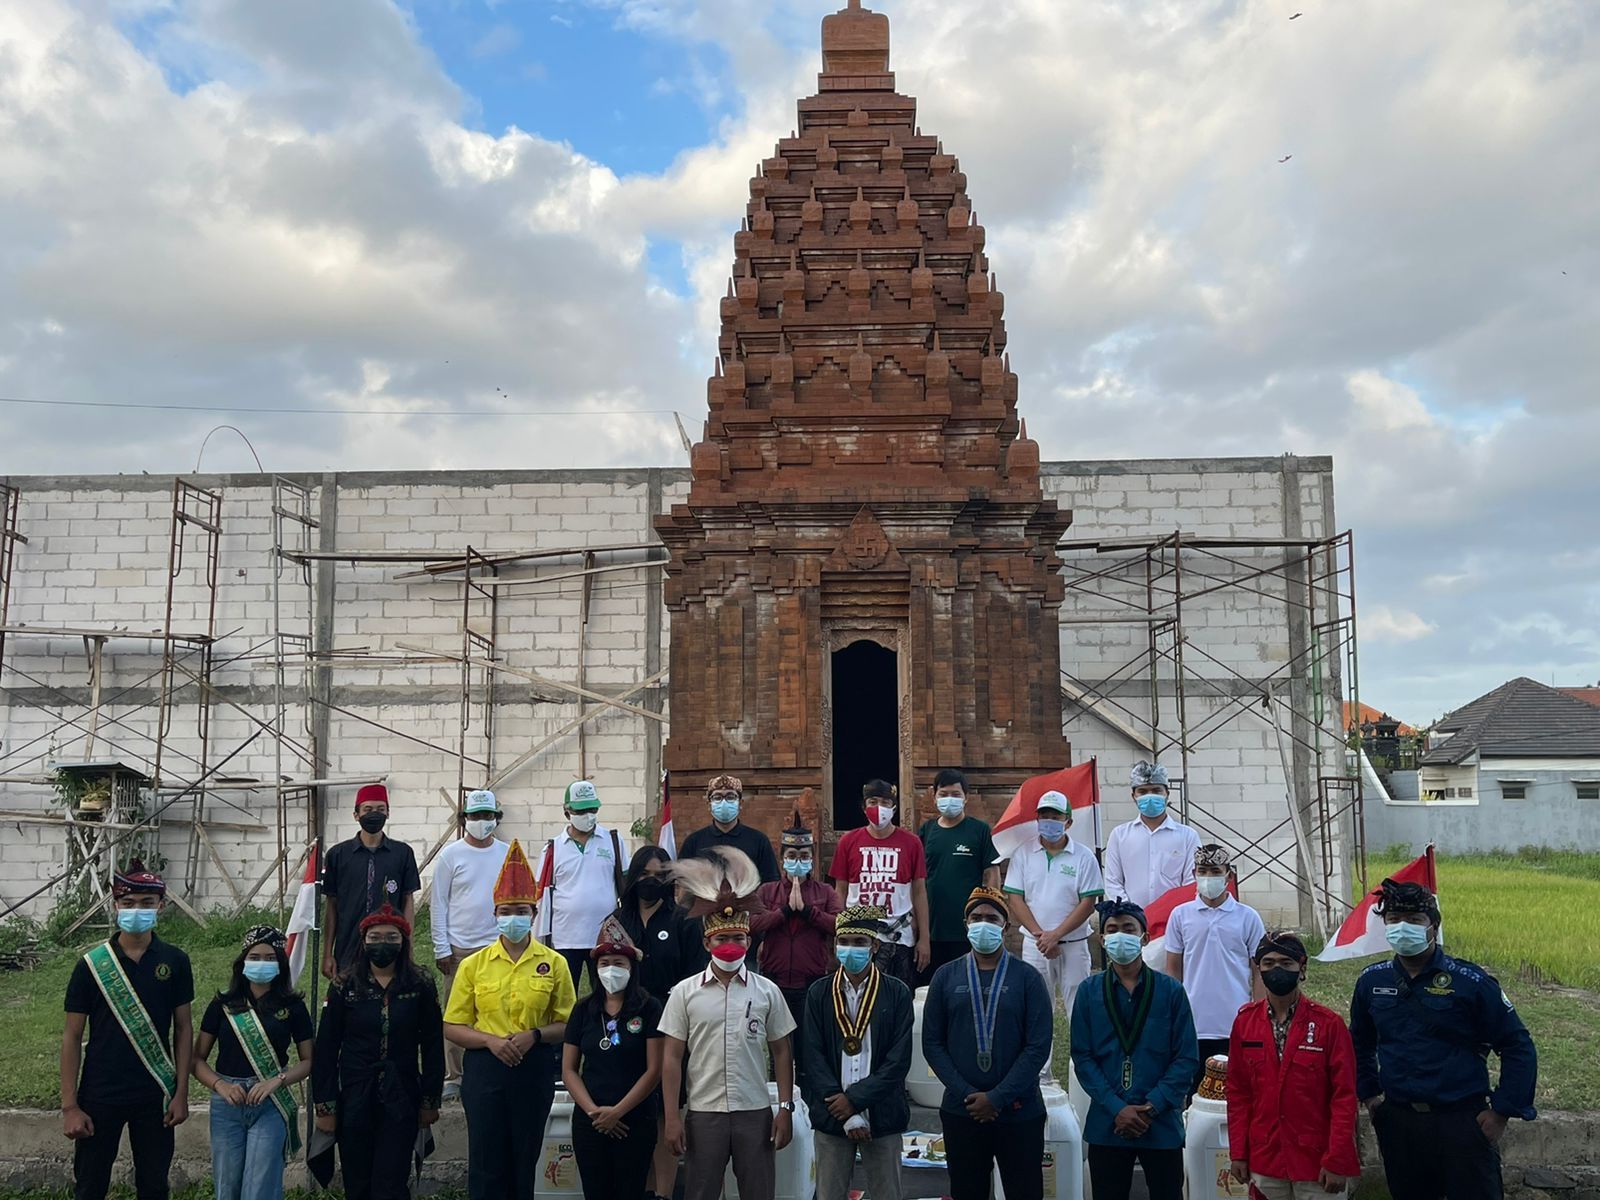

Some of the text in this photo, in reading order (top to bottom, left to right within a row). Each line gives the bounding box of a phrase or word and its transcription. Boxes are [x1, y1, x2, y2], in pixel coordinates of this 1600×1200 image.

[861, 851, 899, 872] IND
[860, 872, 897, 893] ONE
[108, 970, 129, 1001] DUTA
[242, 1013, 260, 1040] DUTA
